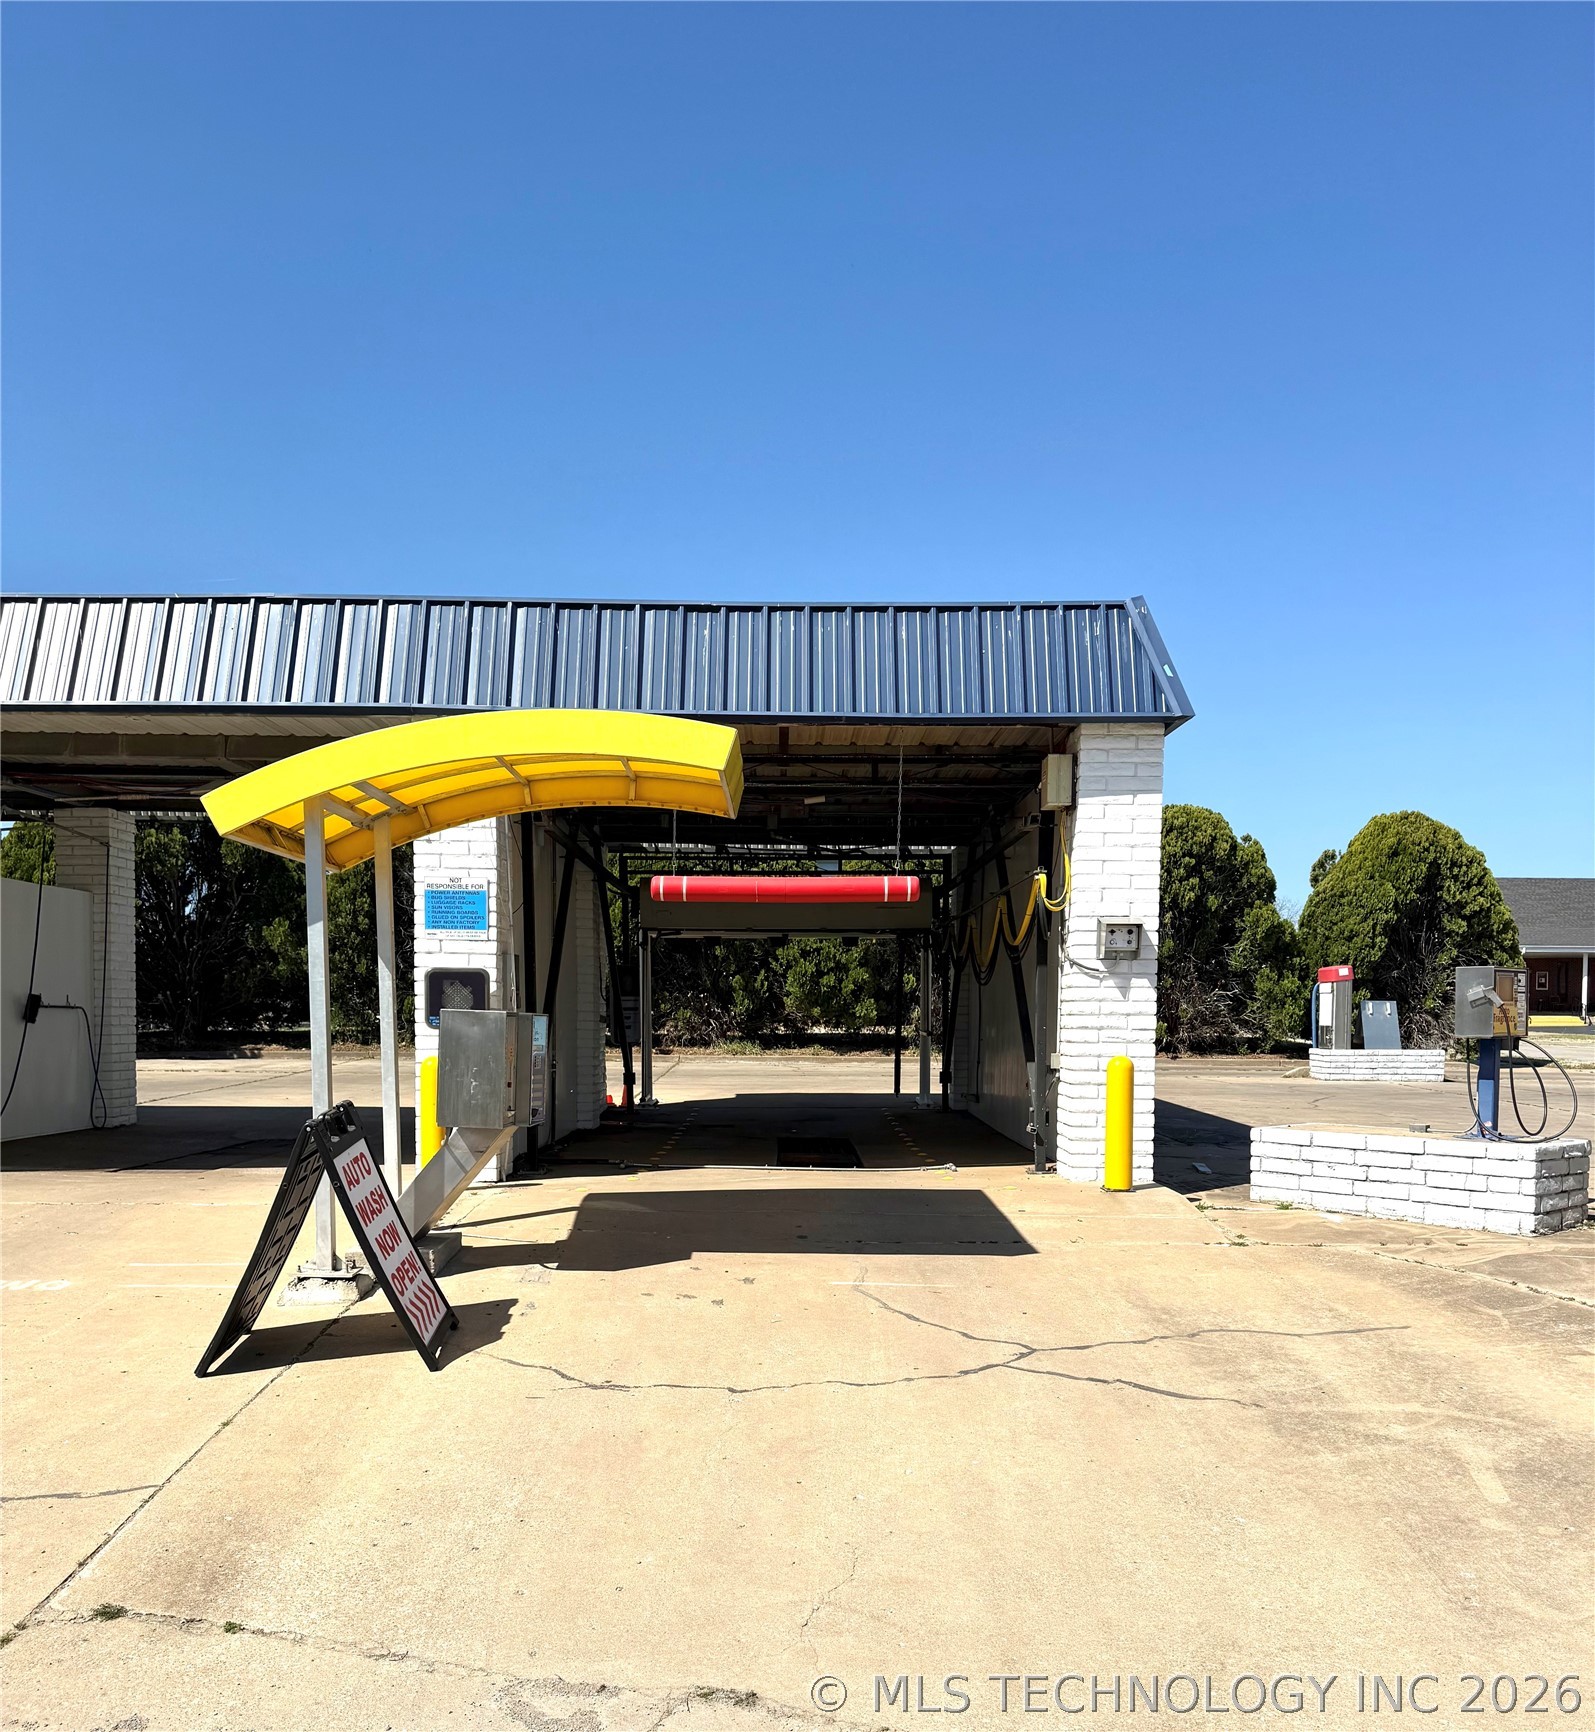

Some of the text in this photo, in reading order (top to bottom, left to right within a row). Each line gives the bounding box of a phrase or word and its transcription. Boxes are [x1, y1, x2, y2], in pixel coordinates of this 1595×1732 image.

[342, 1151, 372, 1191] AUTO
[355, 1184, 389, 1227] WASH
[374, 1220, 402, 1261] NOW
[390, 1250, 422, 1297] OPEN!
